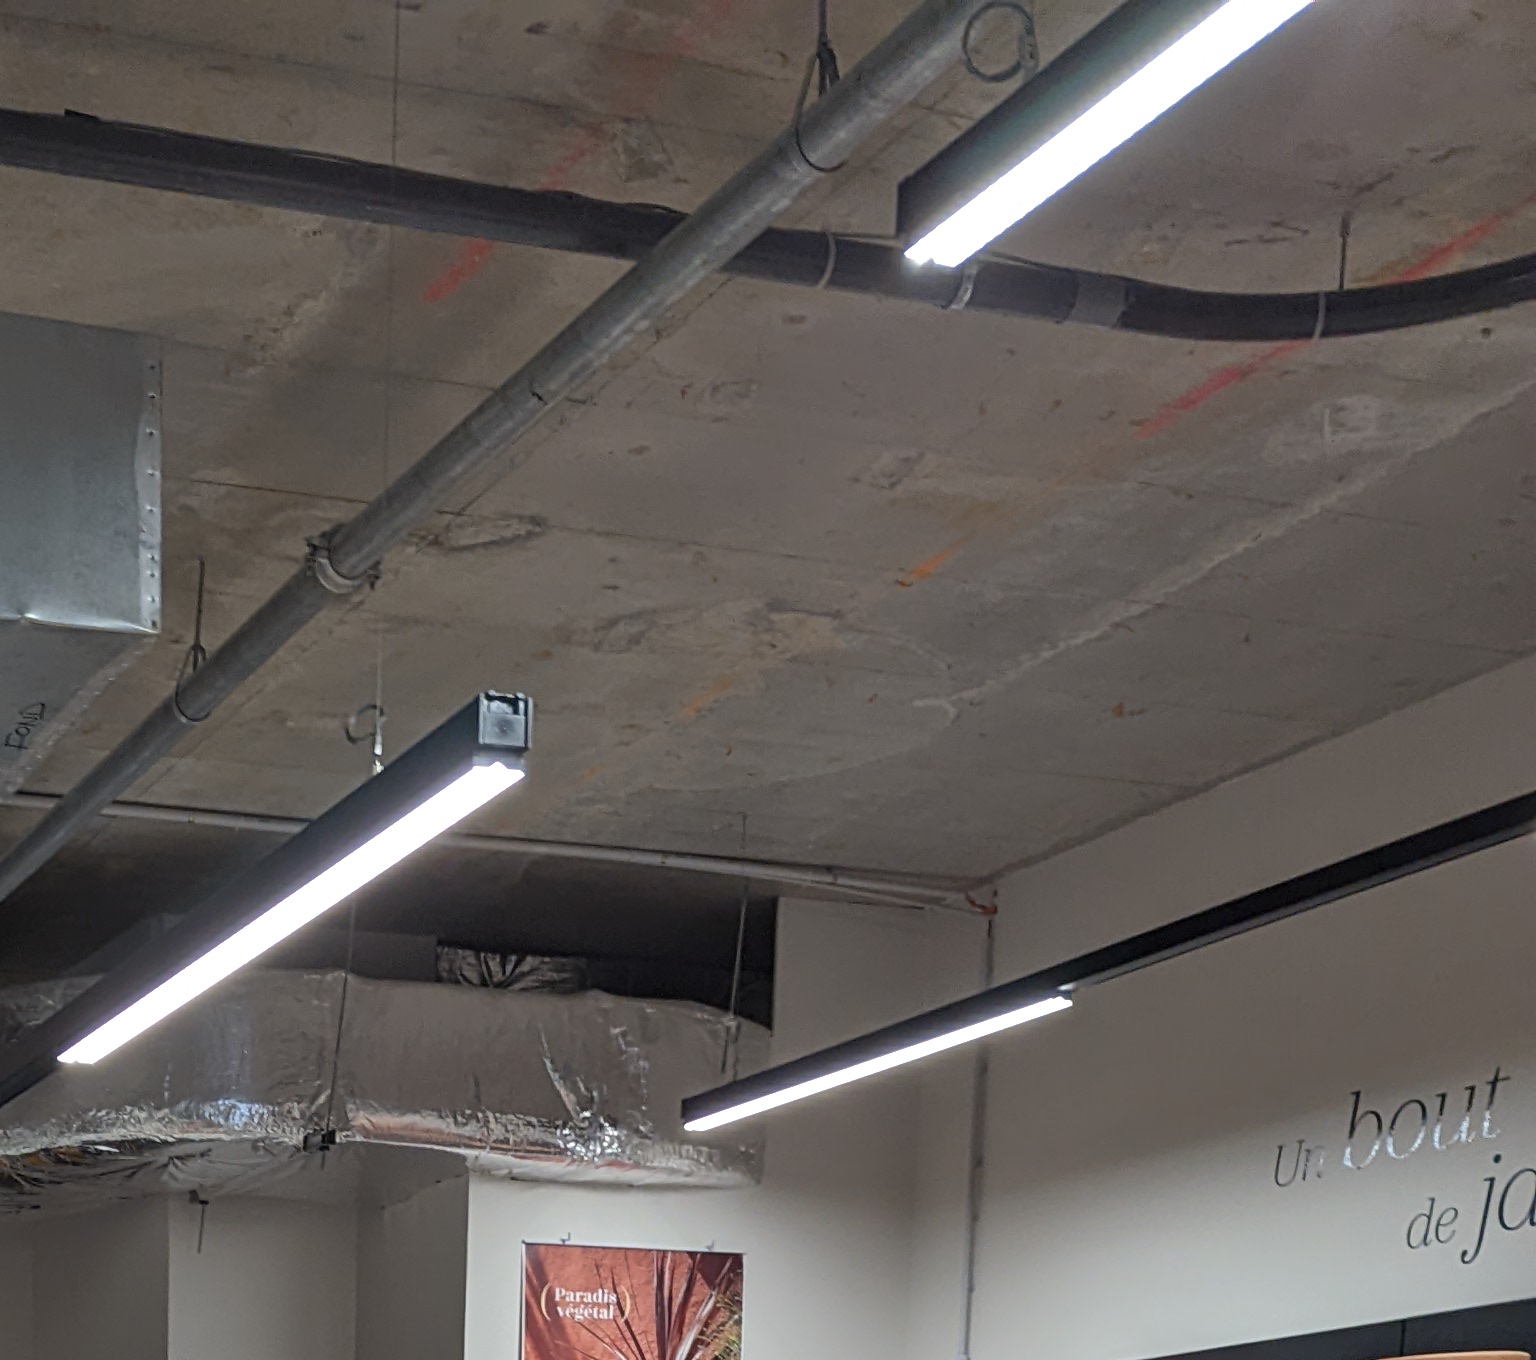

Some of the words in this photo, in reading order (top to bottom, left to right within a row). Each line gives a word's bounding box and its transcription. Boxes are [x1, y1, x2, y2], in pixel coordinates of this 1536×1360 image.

[4, 702, 46, 751] FOND
[1274, 1138, 1327, 1188] Un
[1343, 1066, 1511, 1170] bout
[1406, 1197, 1460, 1250] de
[1460, 1153, 1536, 1265] ja
[554, 1287, 619, 1304] Paradis
[556, 1303, 615, 1322] végétal
